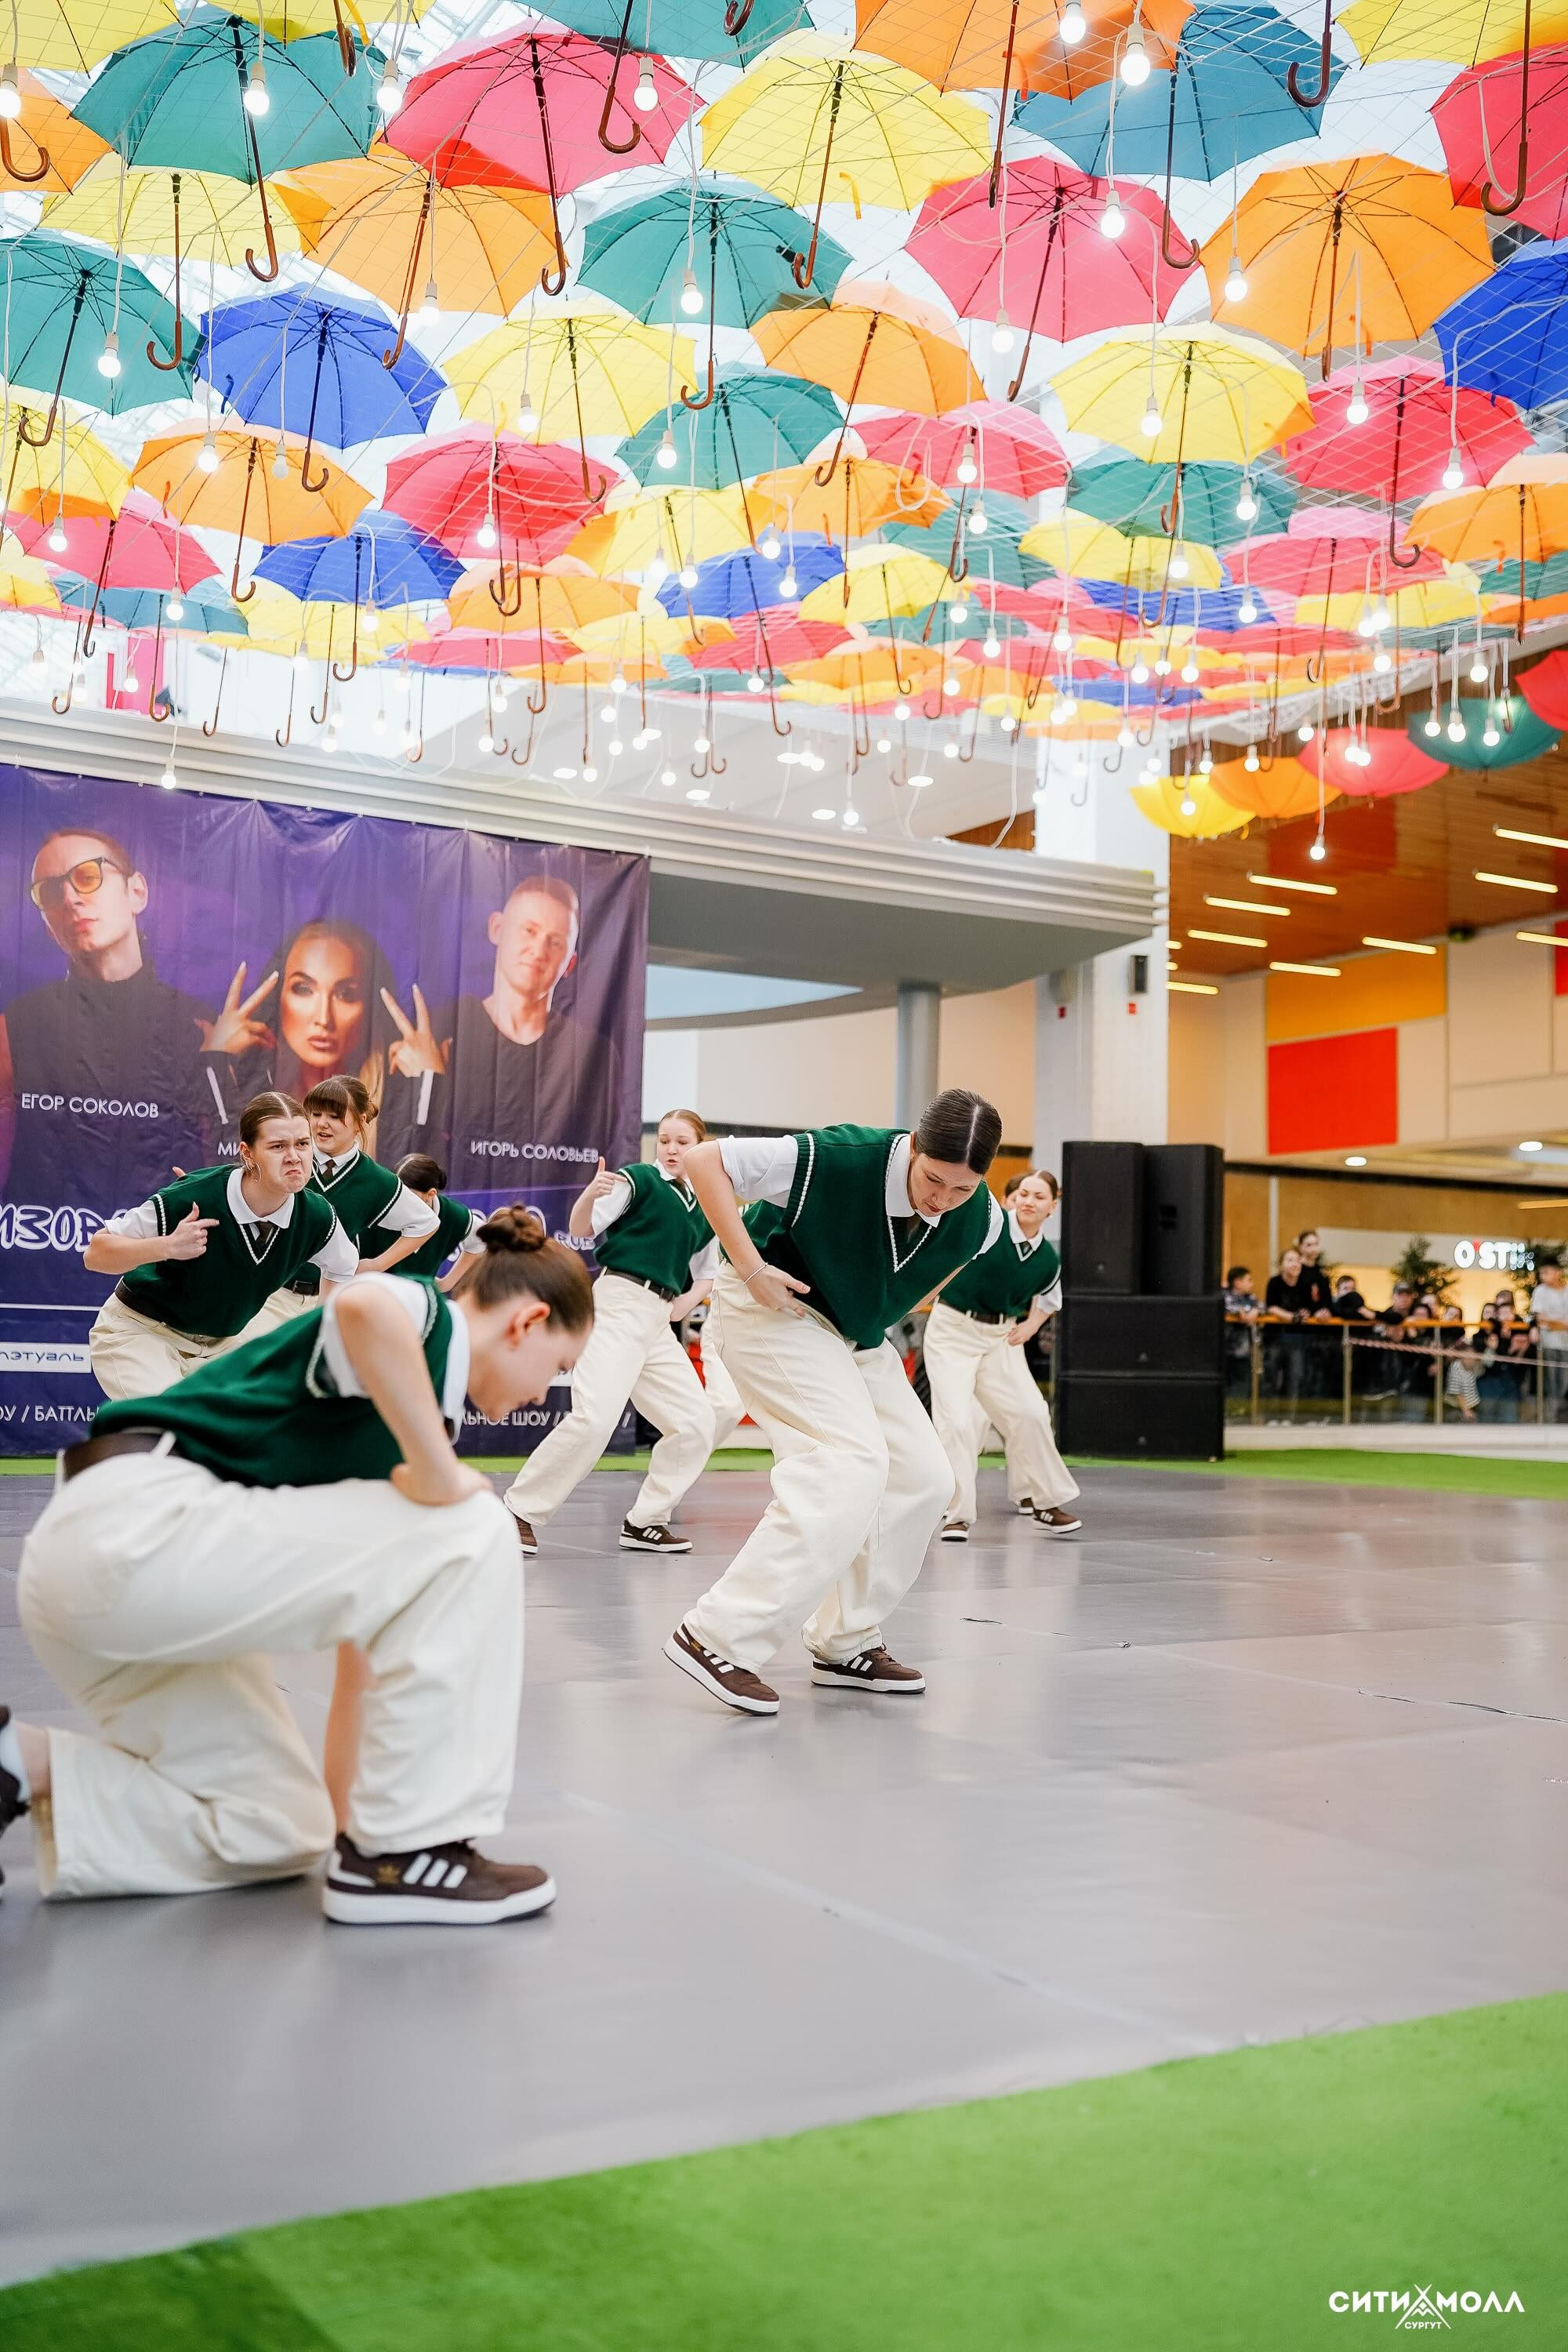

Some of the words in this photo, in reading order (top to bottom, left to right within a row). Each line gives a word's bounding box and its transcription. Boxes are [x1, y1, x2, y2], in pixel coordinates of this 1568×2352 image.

[21, 1092, 64, 1112] ЕГОР
[69, 1096, 159, 1119] СОКОЛОВ
[470, 1140, 519, 1158] ИГОРЬ
[521, 1142, 599, 1163] СОЛОВЬЕВ
[511, 1410, 551, 1426] ШОУ
